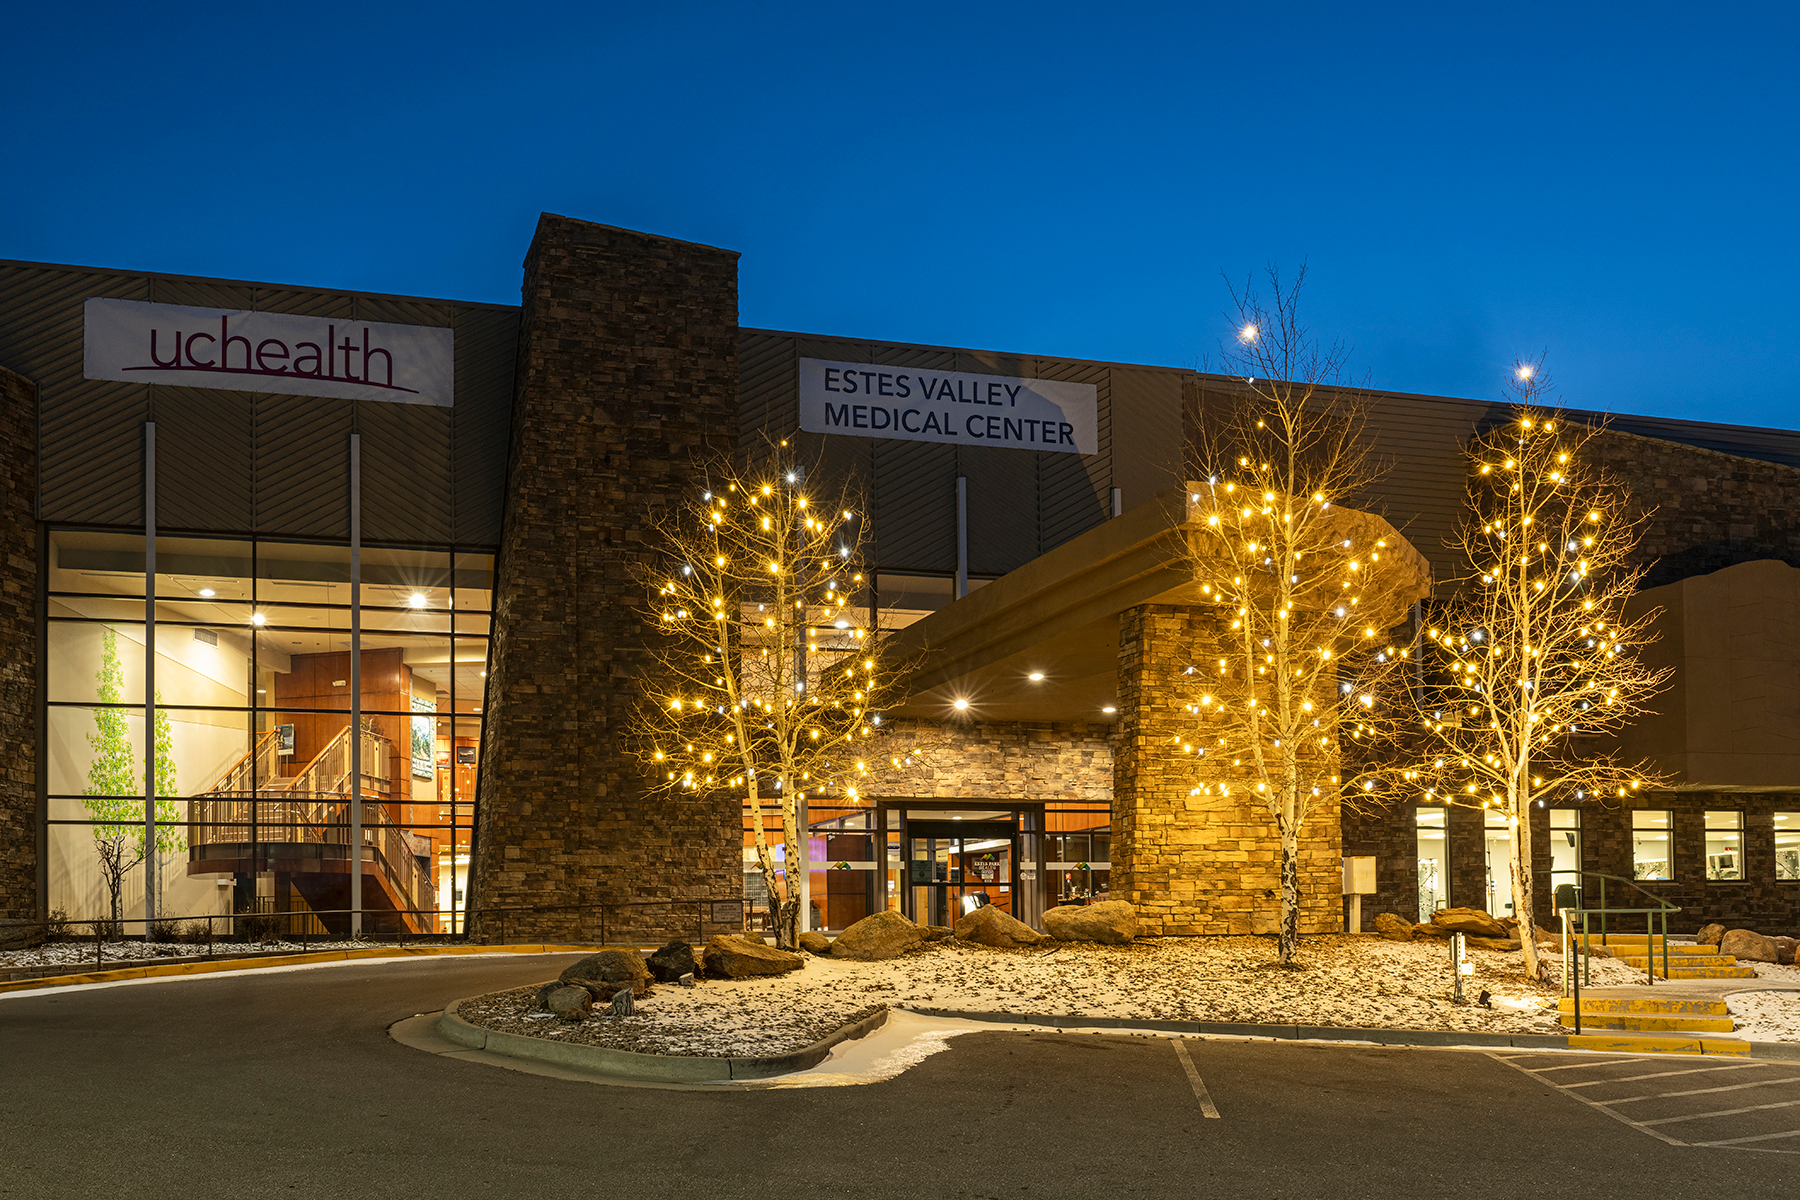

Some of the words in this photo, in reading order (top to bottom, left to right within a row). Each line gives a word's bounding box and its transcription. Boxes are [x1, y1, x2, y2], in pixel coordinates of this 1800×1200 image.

[150, 315, 393, 387] uchealth
[824, 367, 911, 398] ESTES
[918, 377, 1022, 407] VALLEY
[825, 402, 958, 436] MEDICAL
[965, 414, 1075, 446] CENTER
